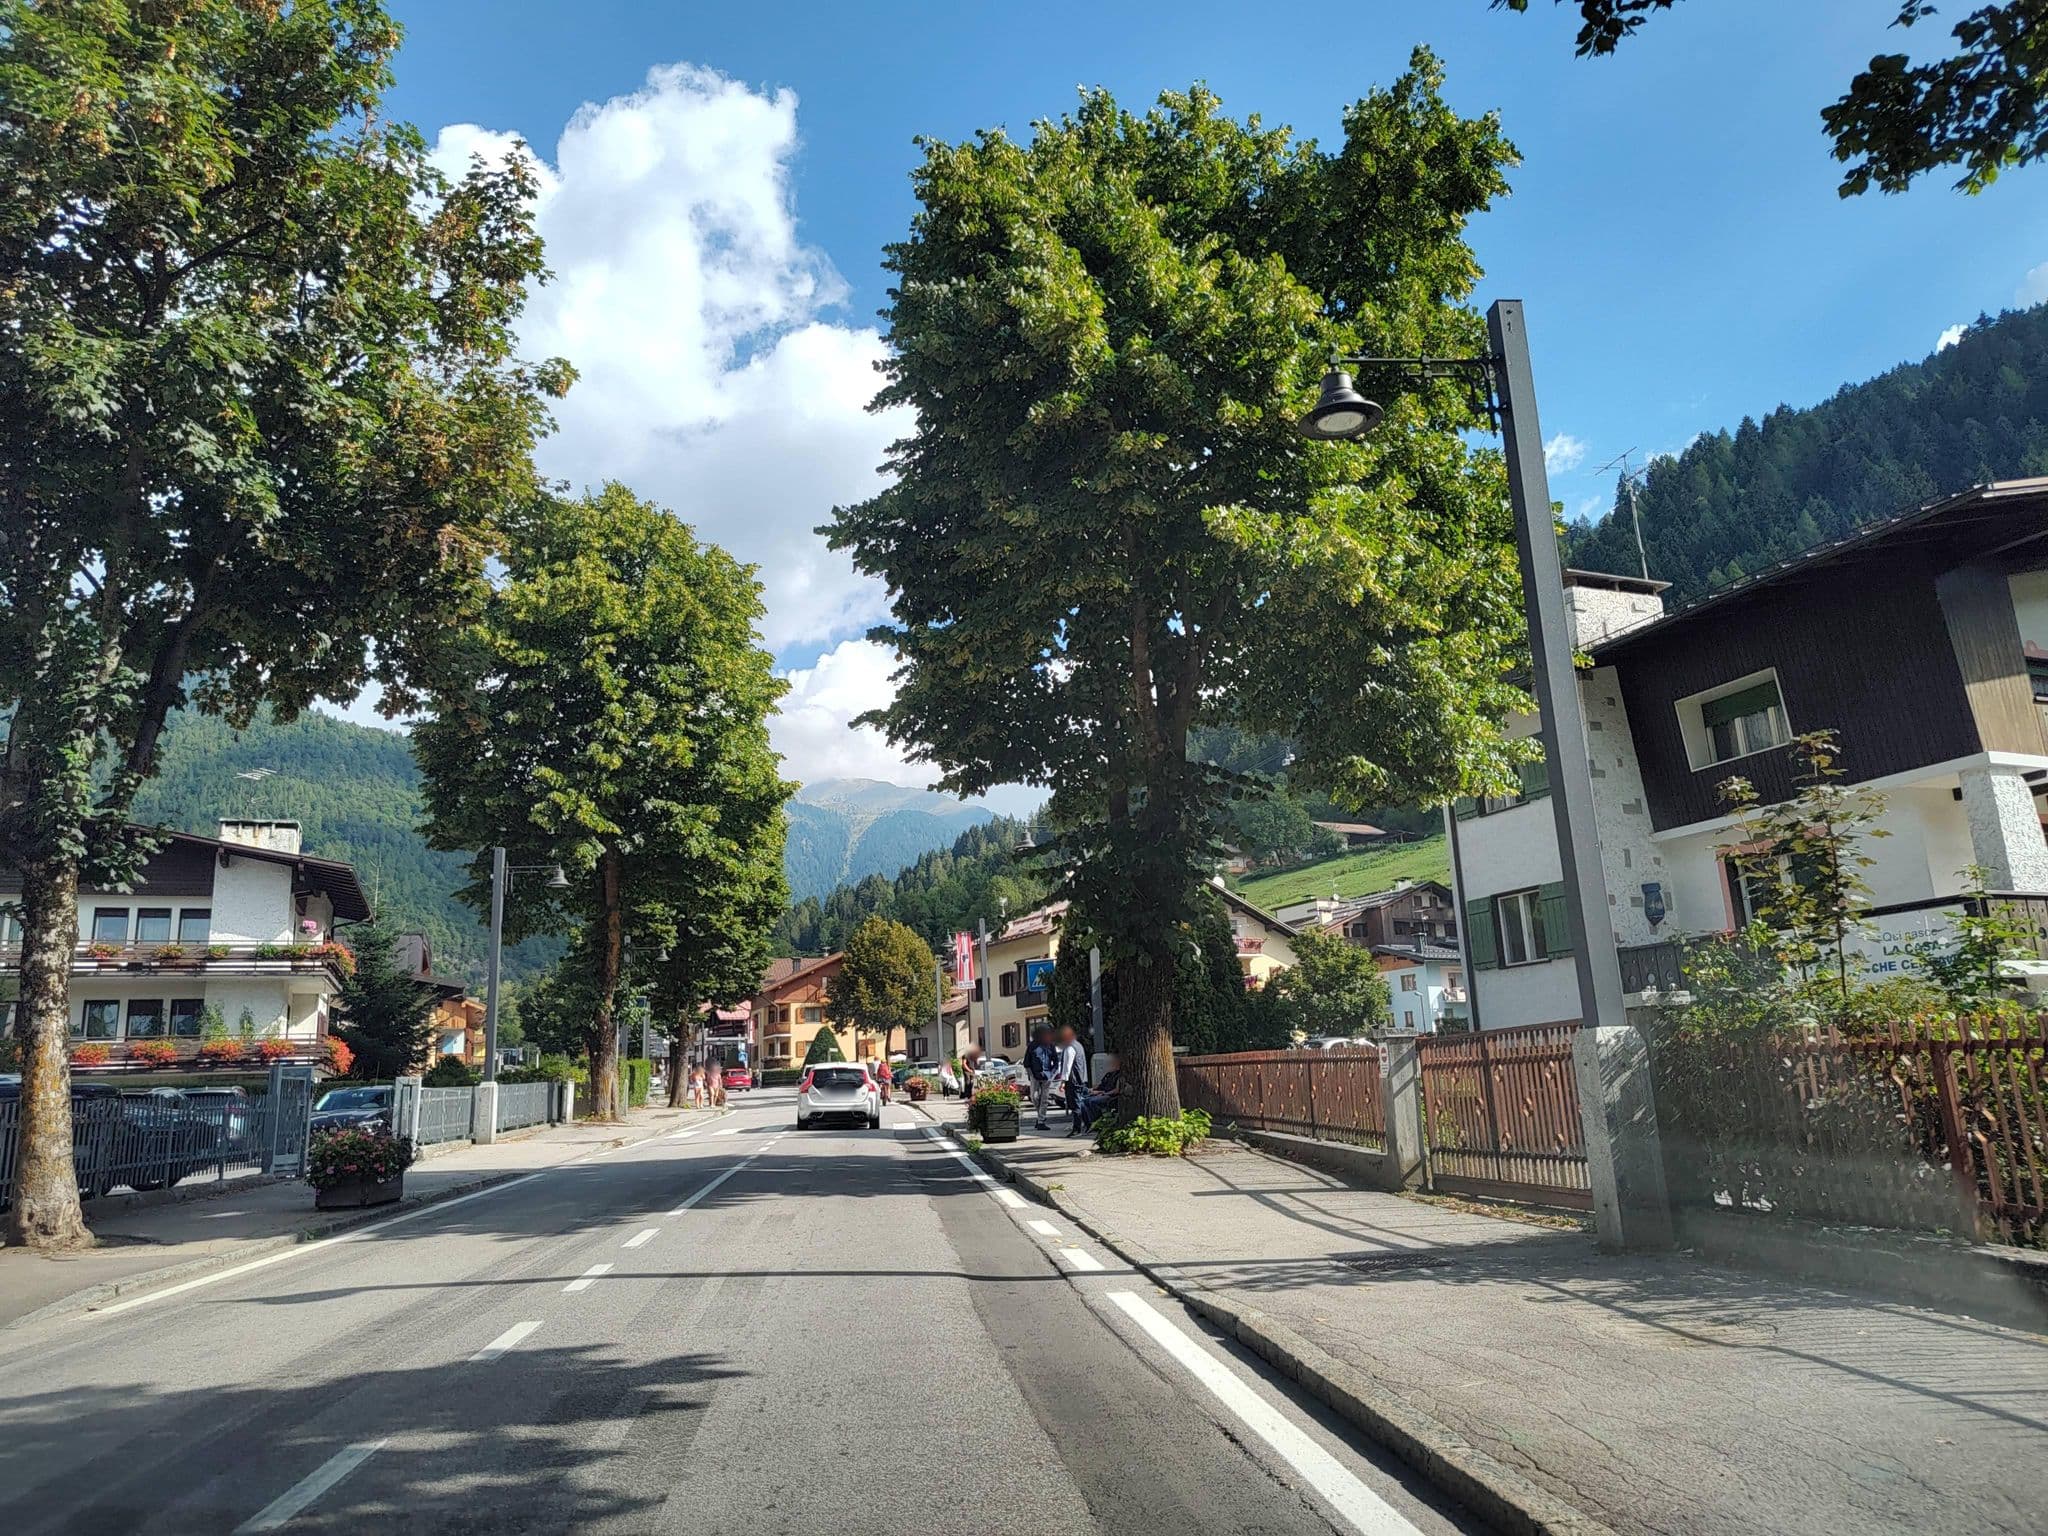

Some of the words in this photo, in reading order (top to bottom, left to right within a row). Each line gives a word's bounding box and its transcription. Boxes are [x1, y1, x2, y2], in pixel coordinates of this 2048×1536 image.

[1883, 945, 1901, 956] LA
[1904, 940, 1940, 954] CASA
[1871, 961, 1897, 974] CHE
